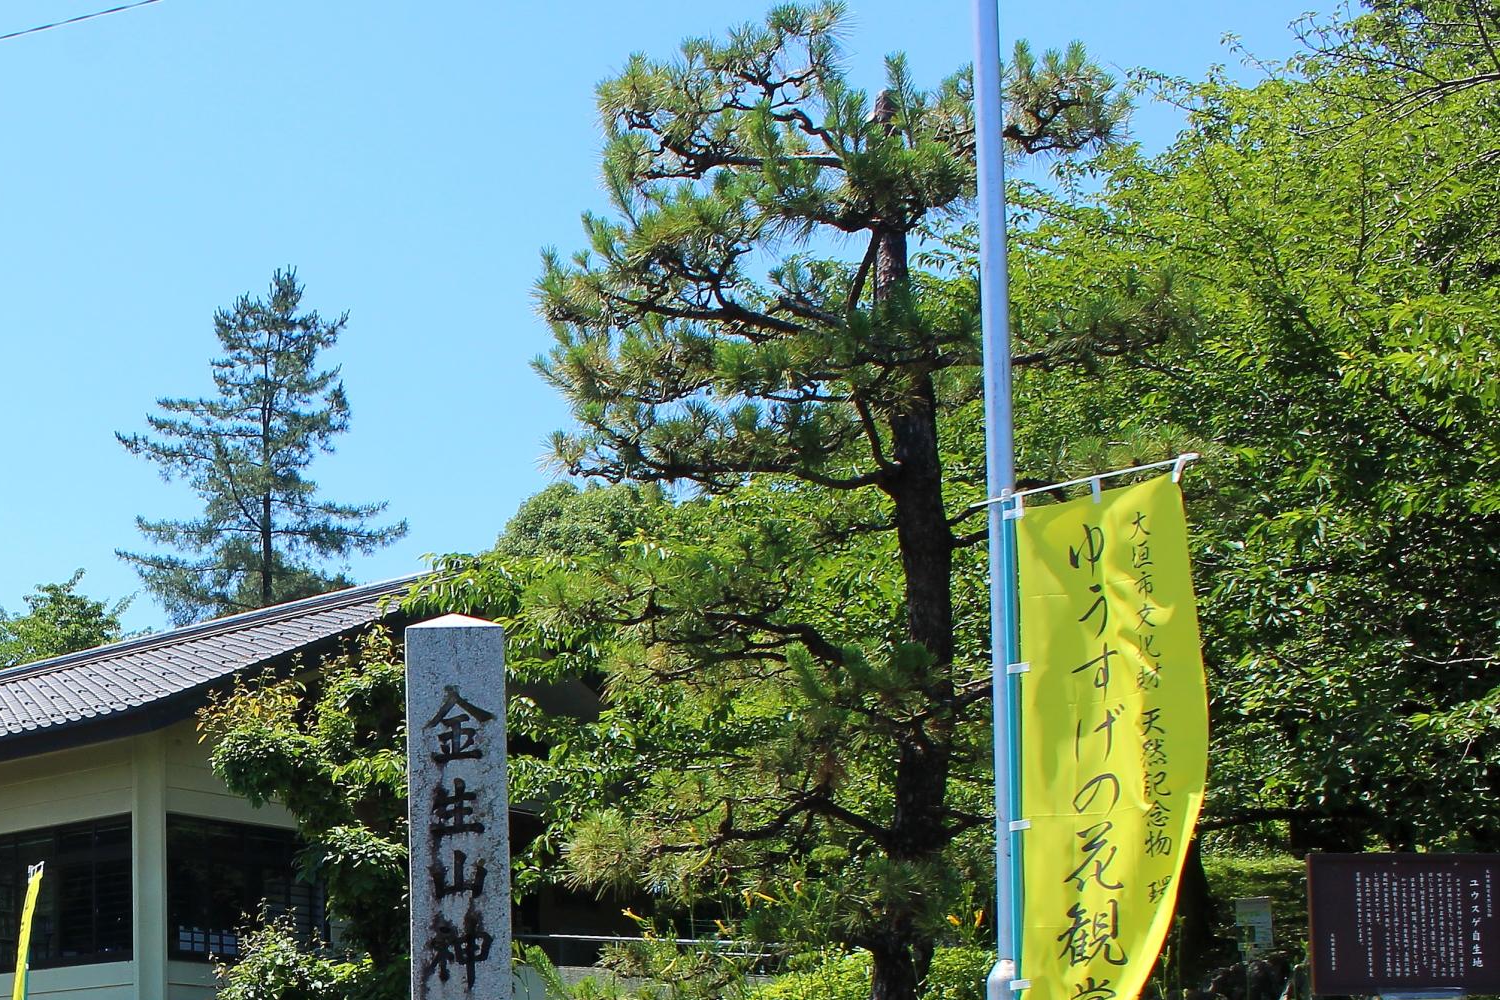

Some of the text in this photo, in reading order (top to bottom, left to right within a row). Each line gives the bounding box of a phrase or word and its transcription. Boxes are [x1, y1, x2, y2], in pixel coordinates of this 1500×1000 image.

[1129, 511, 1162, 690] 大垣市文化財
[1140, 707, 1173, 858] 天然記念物
[1469, 878, 1484, 969] ユウスゲ自生地
